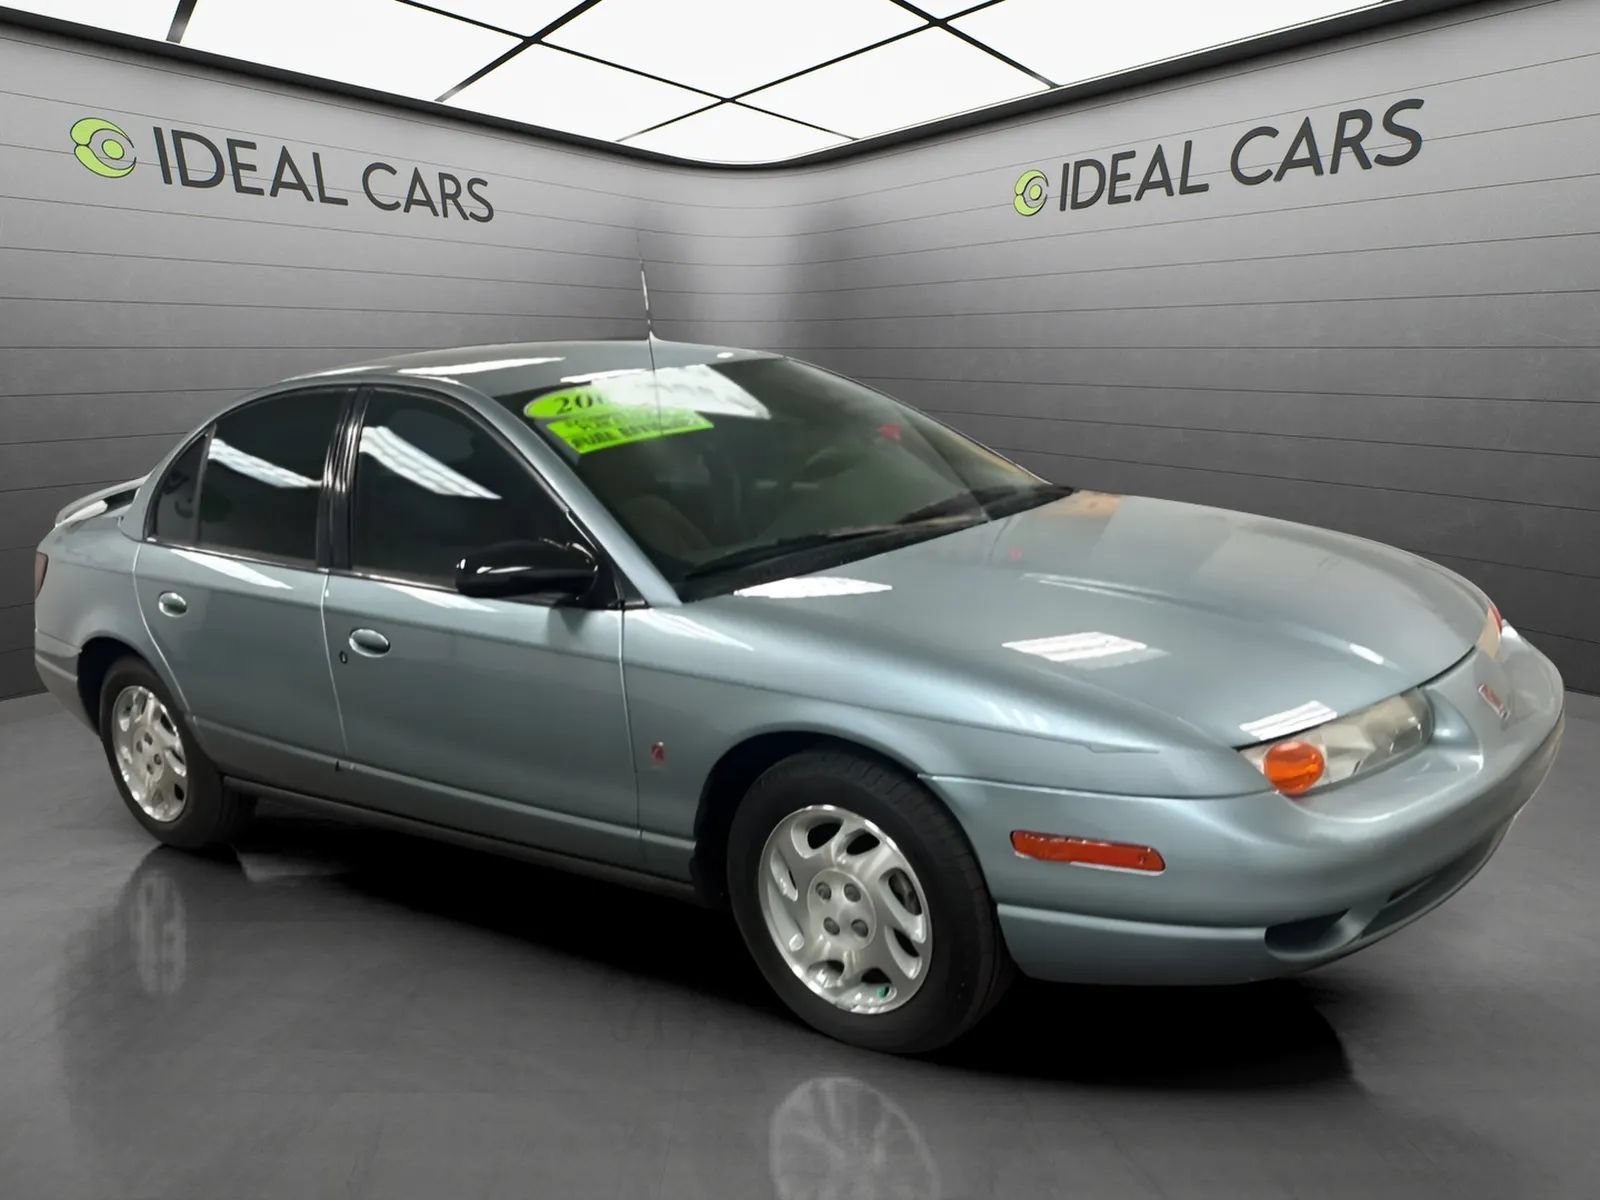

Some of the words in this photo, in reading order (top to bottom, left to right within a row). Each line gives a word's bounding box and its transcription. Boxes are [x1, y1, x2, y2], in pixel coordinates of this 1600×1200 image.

[152, 126, 349, 206] IDEAL
[361, 162, 494, 223] CARS
[1058, 140, 1209, 211] IDEAL
[1230, 98, 1424, 186] CARS
